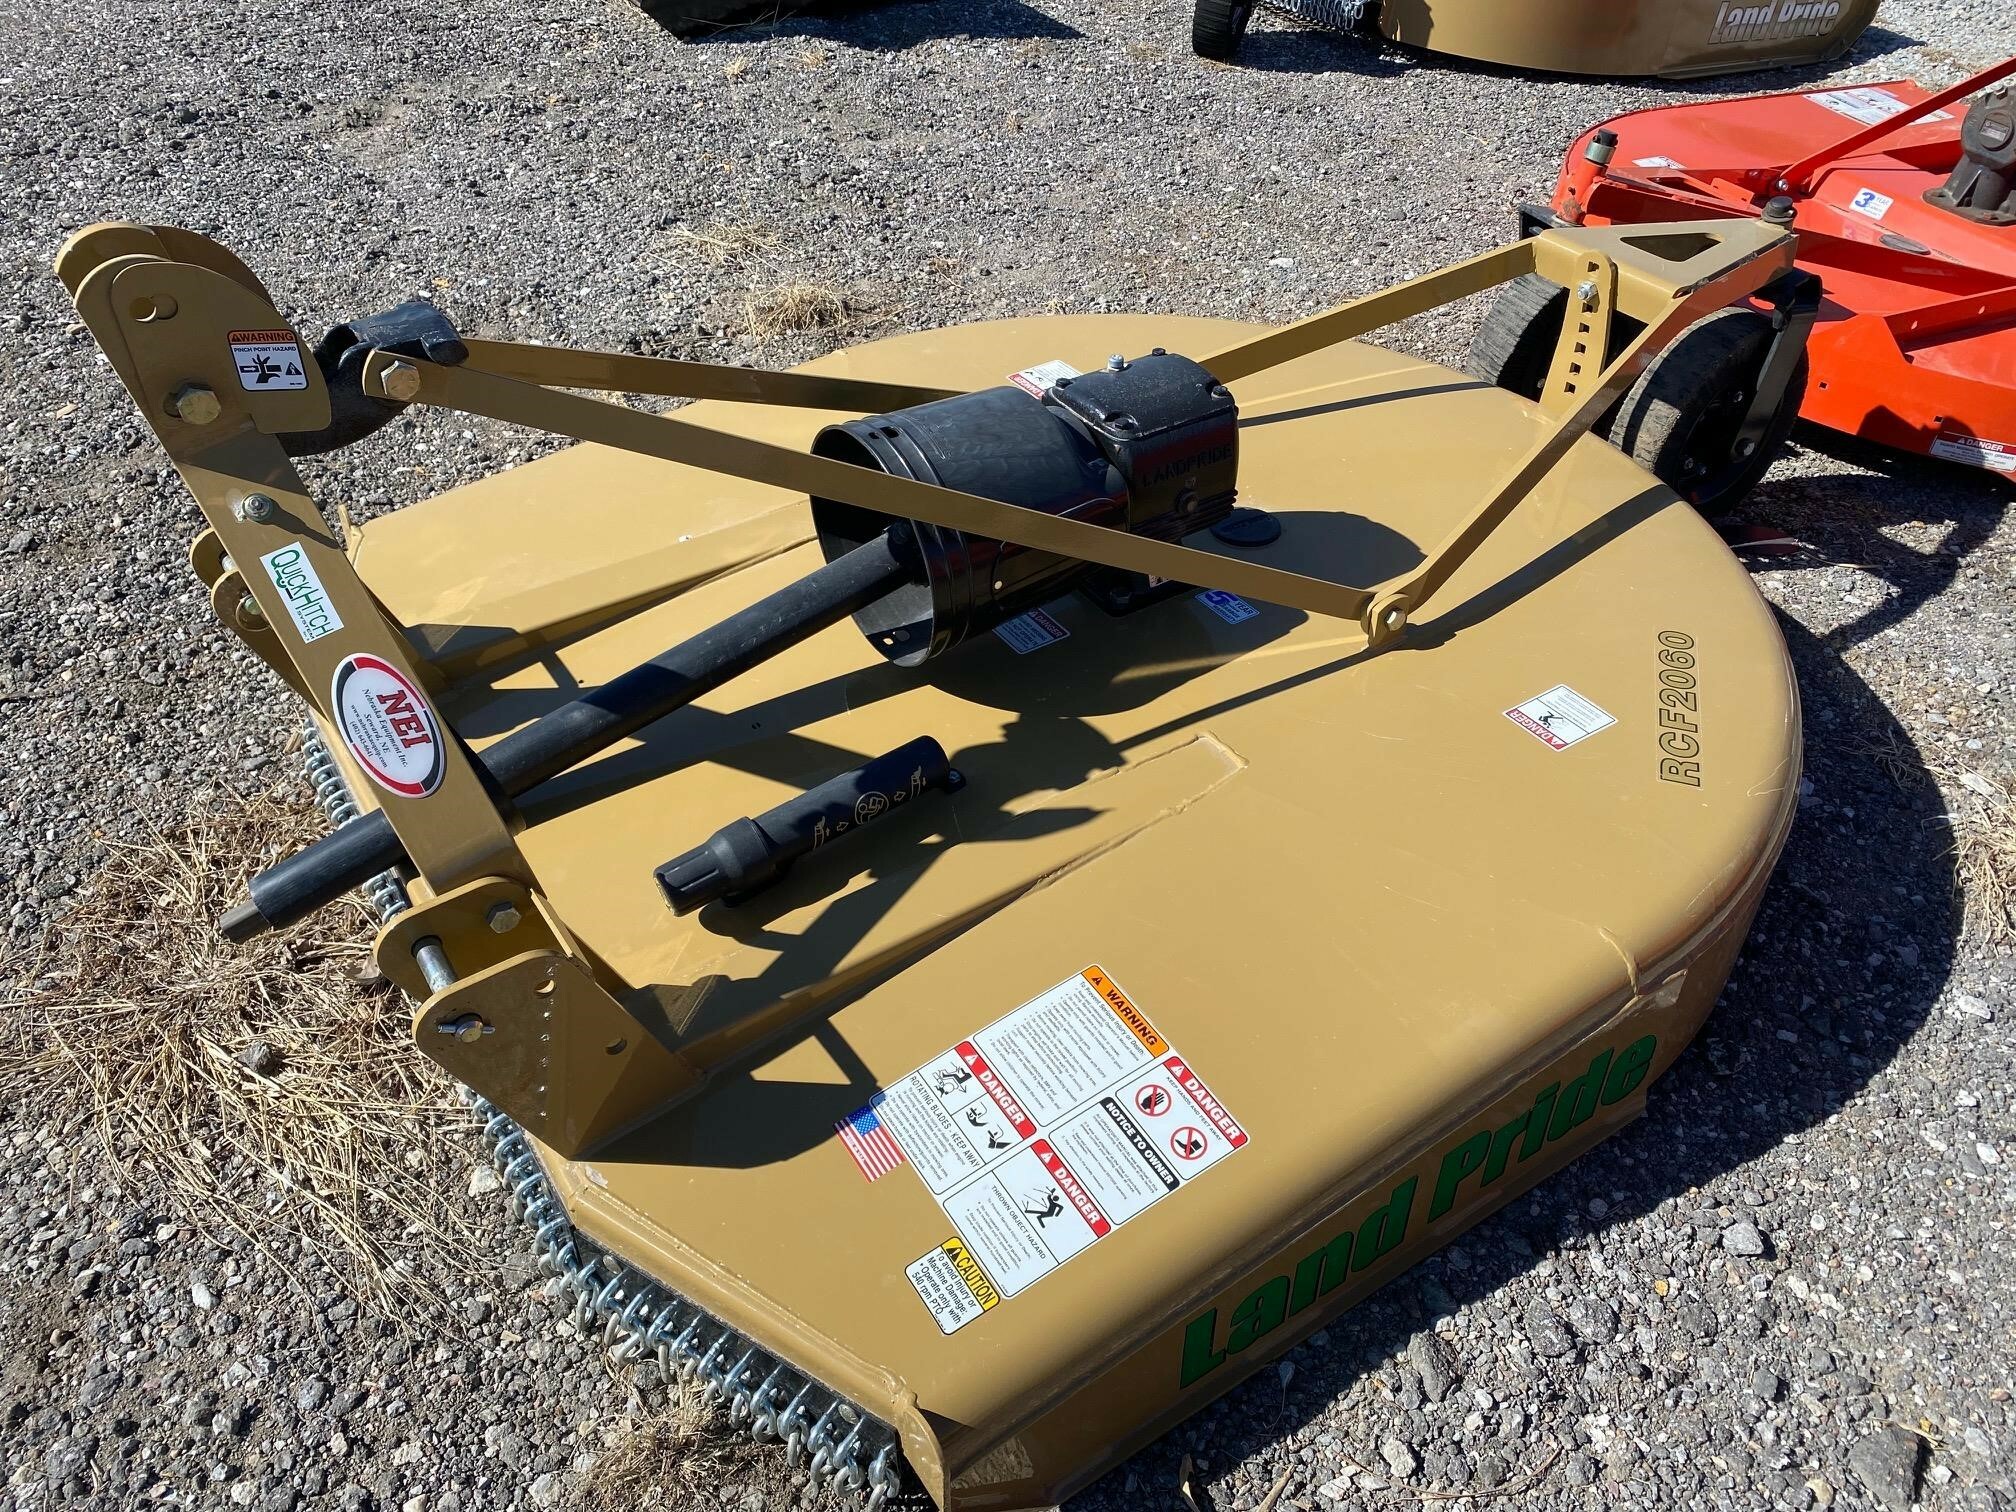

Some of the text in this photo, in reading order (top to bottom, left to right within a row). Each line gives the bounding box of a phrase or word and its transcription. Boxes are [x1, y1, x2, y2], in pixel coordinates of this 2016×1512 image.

[1708, 0, 1840, 44] Land Pride
[1855, 191, 1876, 208] 3
[240, 333, 294, 342] WARNING
[1967, 439, 2004, 452] DANGER
[297, 610, 315, 639] SYSTEM
[1036, 616, 1063, 637] DANGER
[1205, 591, 1253, 616] 5 YEAR
[362, 689, 408, 767] Nebraska Equipment Inc.
[364, 714, 390, 753] Seward, NE
[376, 689, 432, 749] NEI
[1510, 710, 1554, 739] DANGER
[1657, 630, 1701, 787] RCF2060
[1084, 987, 1101, 1005] Prevent
[1099, 1004, 1115, 1022] Serious
[1114, 1021, 1127, 1035] Injury
[1105, 989, 1159, 1047] WARNING
[909, 1076, 934, 1106] ROTATING
[930, 1104, 951, 1129] BLADES
[950, 1133, 967, 1149] KEEP
[963, 1150, 980, 1167] AWAY
[979, 1070, 1025, 1125] DANGER
[1166, 1077, 1221, 1140] KEEP HANDS AND FEET AWAY
[1185, 1078, 1240, 1139] DANGER
[1106, 1102, 1136, 1136] NOTICE
[1133, 1135, 1146, 1150] TO
[1144, 1150, 1174, 1184] OWNER
[992, 1185, 1011, 1211] THROWN
[1009, 1210, 1029, 1233] OBJECT
[1026, 1234, 1046, 1259] HAZARD
[1054, 1167, 1100, 1224] DANGER
[1180, 1034, 1658, 1389] Land Pride
[912, 1271, 925, 1285] 540
[920, 1285, 932, 1300] rpm
[929, 1298, 944, 1315] PTO
[921, 1266, 941, 1293] Operate
[935, 1293, 951, 1310] only
[948, 1308, 961, 1324] with
[927, 1256, 967, 1315] Machine Damage:
[936, 1250, 977, 1308] To avoid Injury or
[956, 1256, 996, 1305] CAUTION
